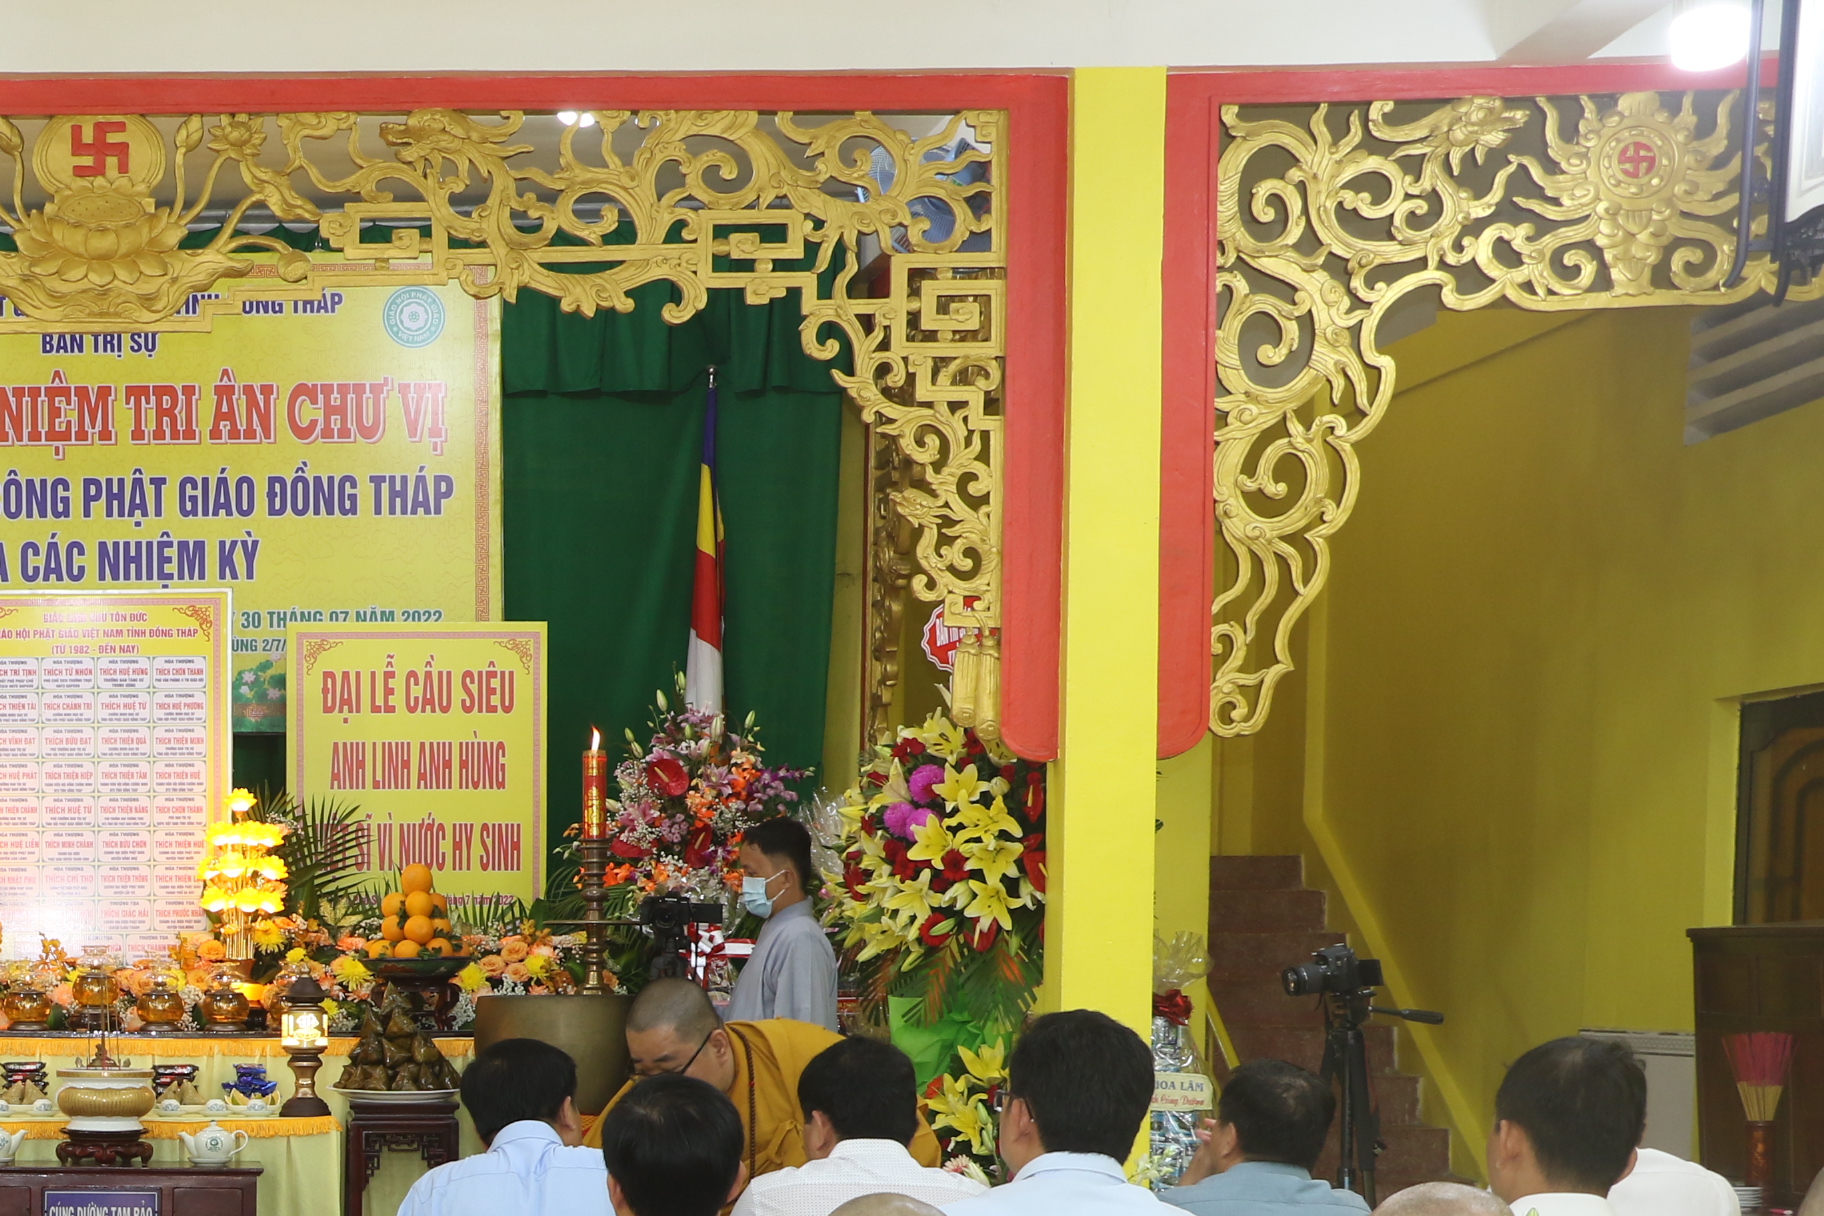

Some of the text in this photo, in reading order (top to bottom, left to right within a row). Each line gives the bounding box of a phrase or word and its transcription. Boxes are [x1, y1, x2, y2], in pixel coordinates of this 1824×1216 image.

[42, 332, 159, 358] BAN TRỊ SỰ
[125, 383, 201, 444] TRI
[209, 367, 279, 444] ÂN
[286, 376, 394, 443] CHƯ
[398, 381, 448, 456] VỊ
[83, 468, 167, 528] PHẬT
[179, 467, 256, 517] GIÁO
[266, 461, 358, 517] ĐỒNG
[369, 465, 455, 516] THÁP
[20, 532, 86, 584] CÁC
[98, 531, 207, 589] NHIỆM
[218, 530, 260, 581] KỲ
[16, 628, 30, 641] HỘI
[33, 628, 55, 641] PHẬT
[59, 628, 79, 639] GIÁO
[82, 627, 99, 641] VIỆT
[103, 629, 123, 638] NAM
[126, 626, 146, 638] TỈNH
[149, 625, 173, 638] ĐỒNG
[176, 626, 199, 638] THÁP
[110, 611, 147, 622] TÔN ĐỨC
[241, 606, 443, 629] 30 THÁNG 07 NĂM 2022
[69, 645, 90, 654] 1982
[99, 642, 116, 654] ĐẾN
[120, 644, 139, 655] NAY)
[322, 654, 515, 724] ĐẠI LỄ CẦU SIÊU
[330, 730, 506, 790] ANH LINH ANH HÙNG
[355, 812, 521, 872] SĨ VÌ NƯỚC HY SINH
[1180, 1080, 1204, 1092] LÂM
